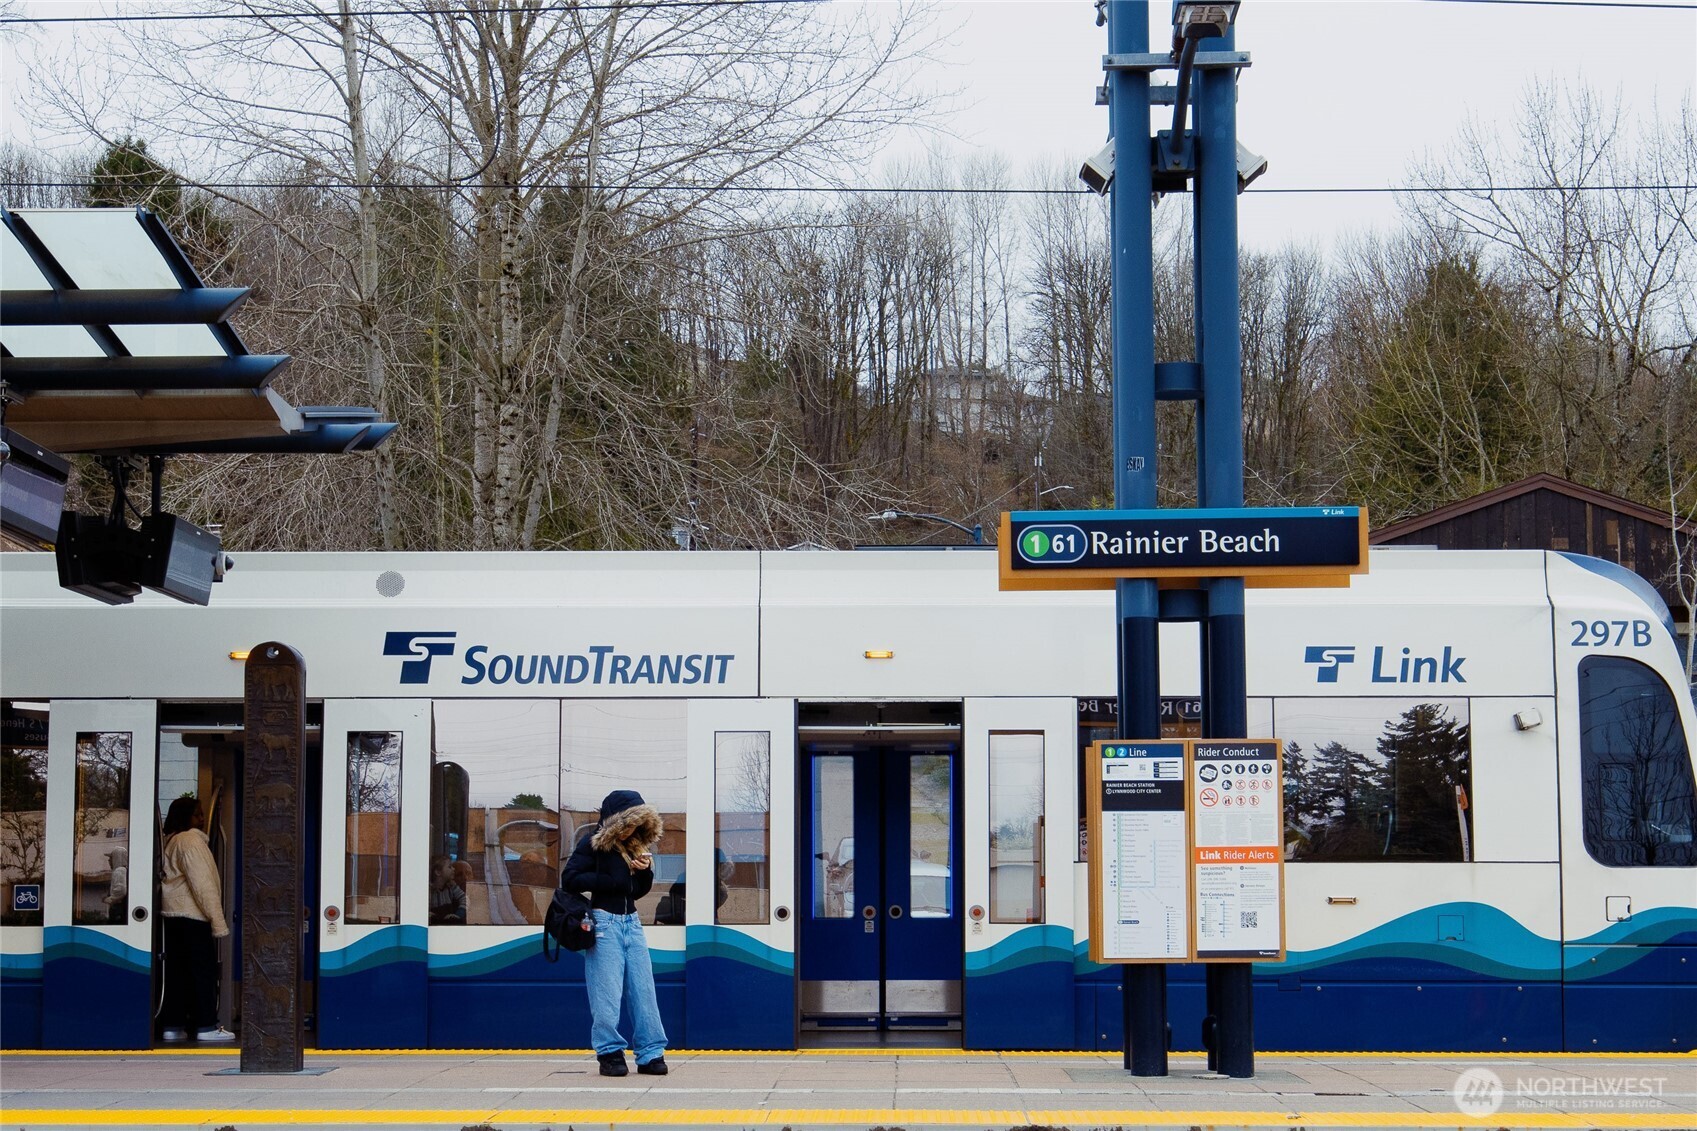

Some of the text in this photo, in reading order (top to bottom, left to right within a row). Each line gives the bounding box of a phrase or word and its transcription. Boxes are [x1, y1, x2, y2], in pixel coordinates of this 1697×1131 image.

[1030, 528, 1280, 555] 1 61 Rainier Beach
[1570, 620, 1652, 647] 297B
[1371, 646, 1468, 683] Link
[1129, 748, 1147, 757] Line
[1198, 747, 1260, 756] Rider Conduct
[1200, 850, 1275, 860] Link Rider Alerts
